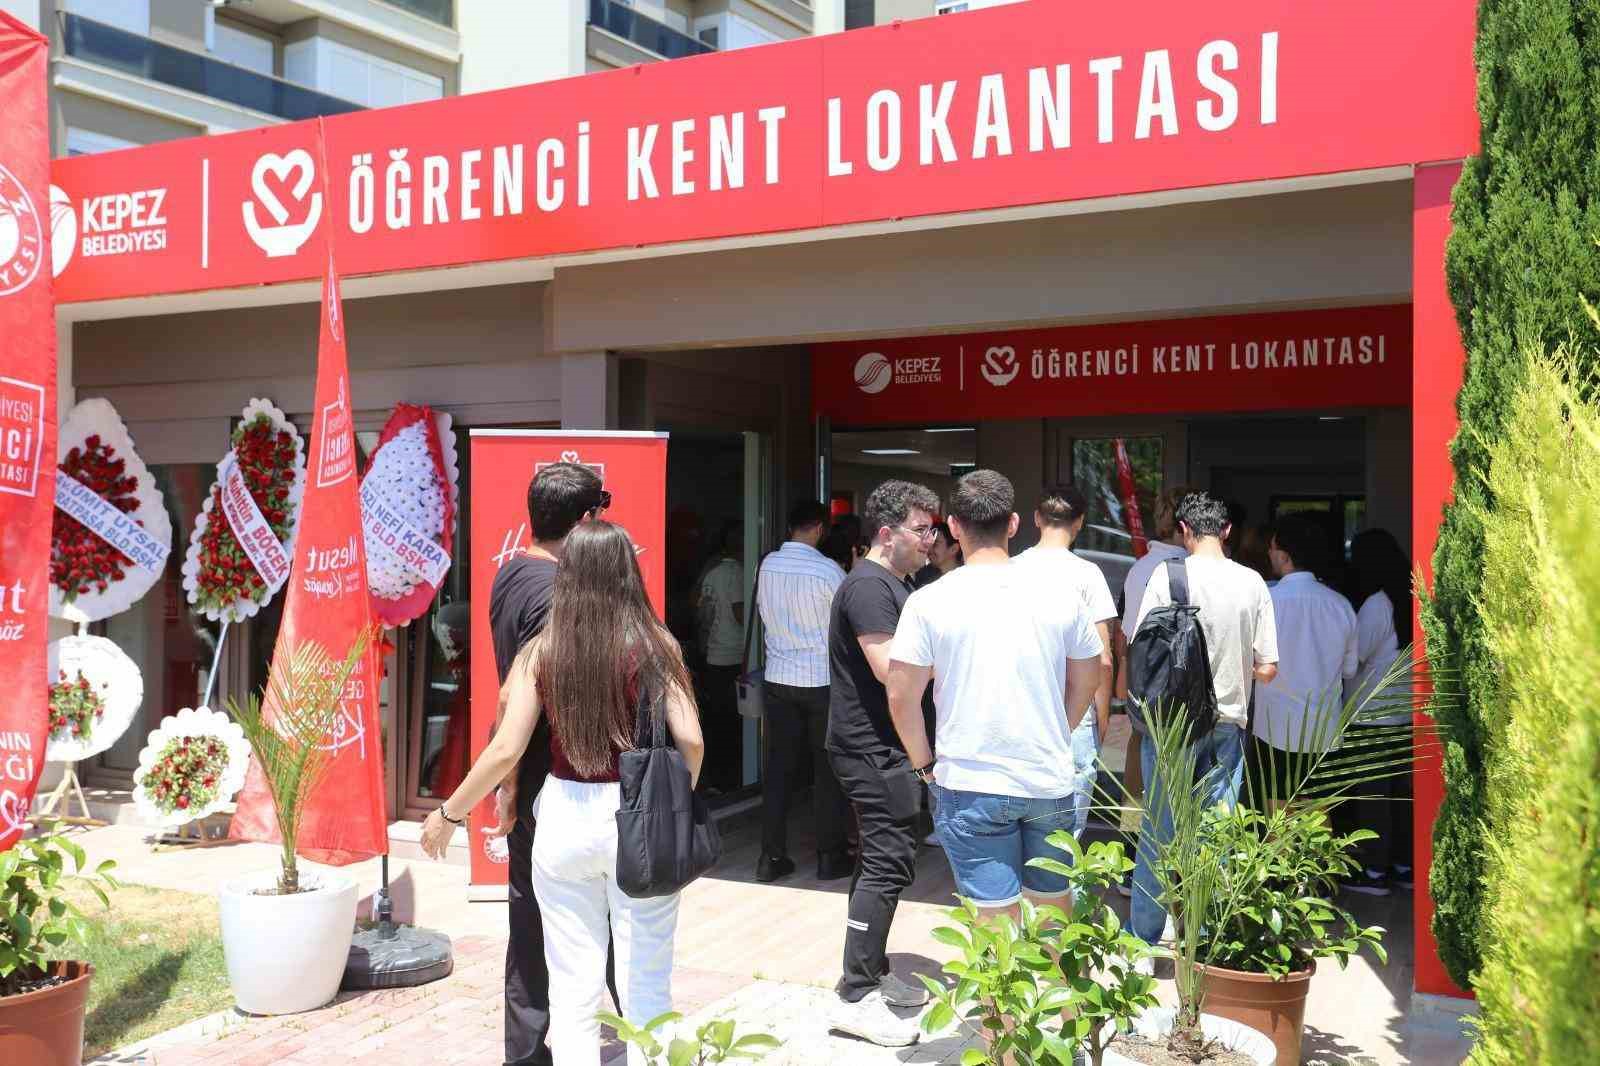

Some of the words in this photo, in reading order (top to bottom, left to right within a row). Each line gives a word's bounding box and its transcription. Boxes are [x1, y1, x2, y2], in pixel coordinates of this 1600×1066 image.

[349, 121, 590, 234] ÖĞRENCİ
[627, 106, 786, 201] KENT
[827, 31, 1278, 177] LOKANTASI
[82, 188, 168, 233] KEPEZ
[82, 229, 167, 256] BELEDİYESİ
[895, 357, 941, 374] KEPEZ
[1031, 344, 1138, 379] ÖĞRENCİ
[1152, 344, 1216, 373] KENT
[1231, 335, 1385, 370] LOKANTASI
[114, 515, 165, 560] UYSAL
[252, 524, 289, 577] BÖCEK
[374, 504, 405, 534] NEFİ
[402, 529, 443, 565] KARA
